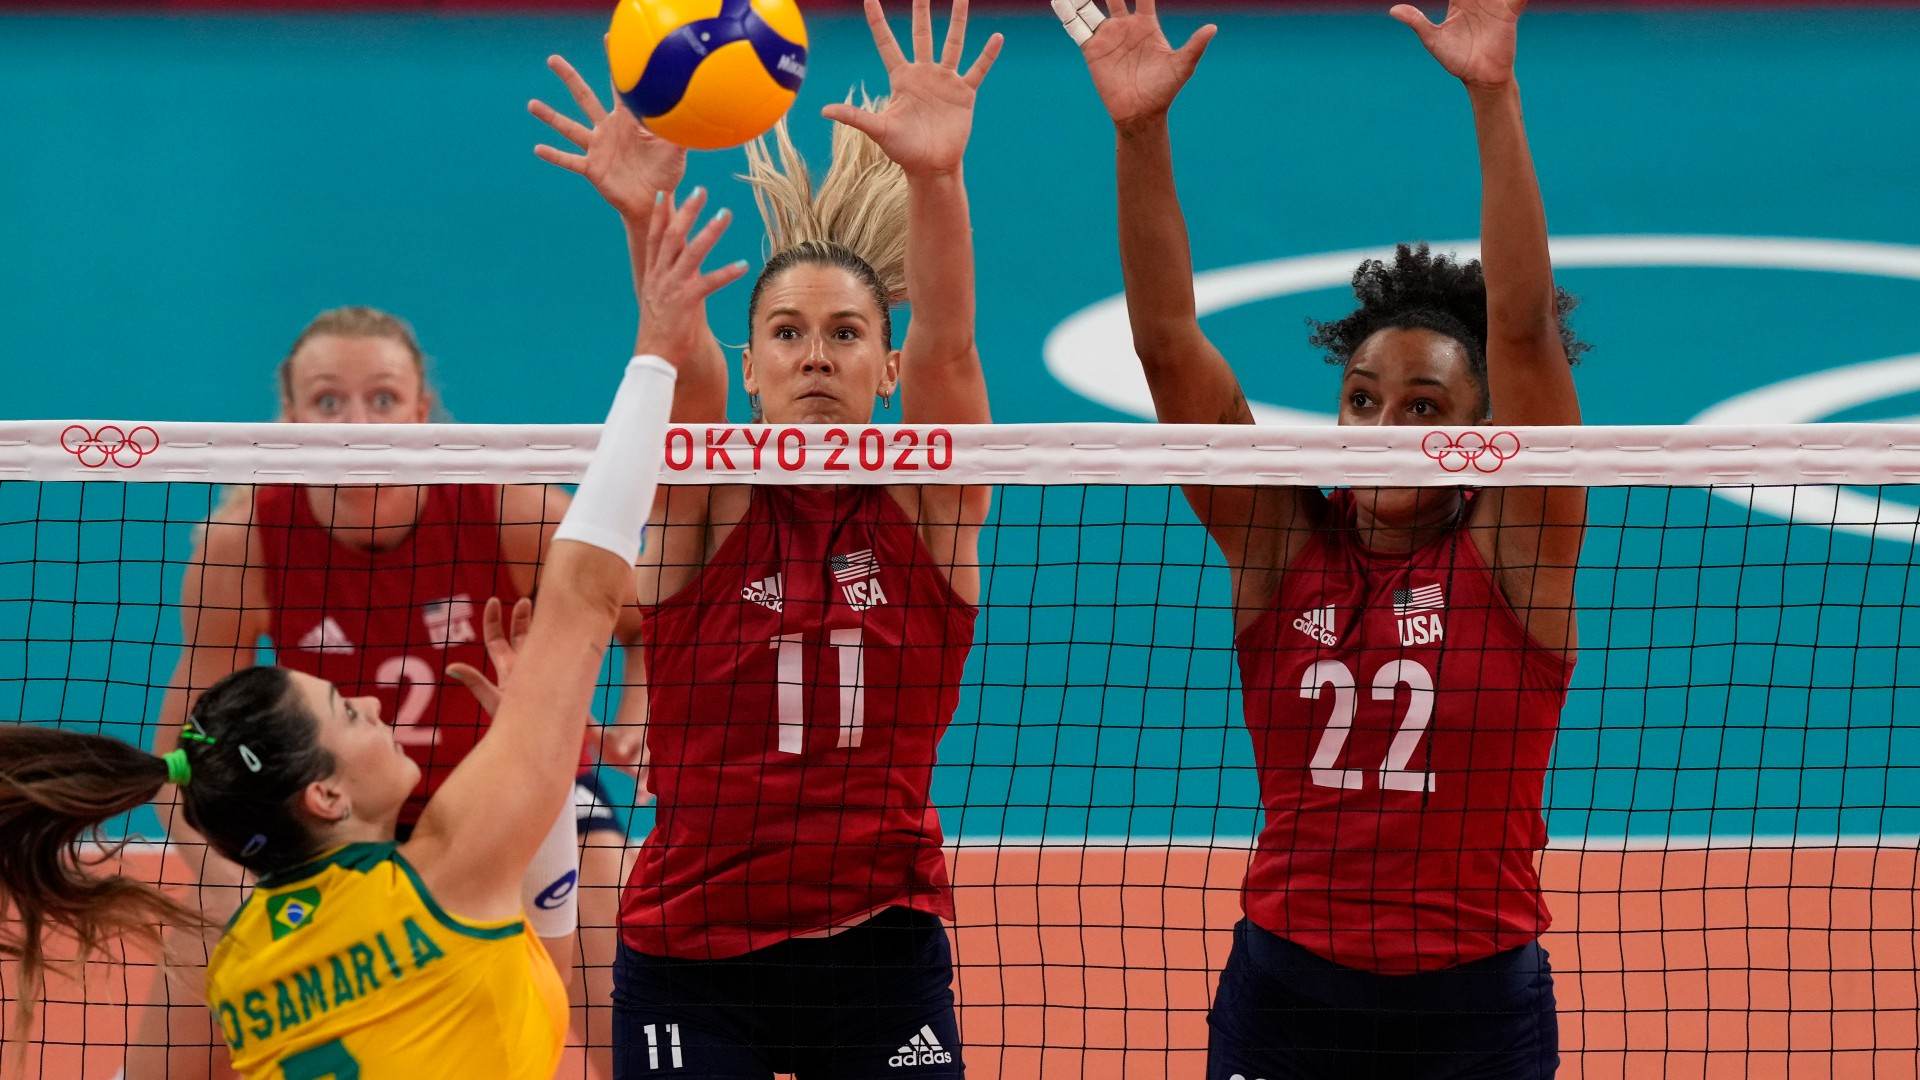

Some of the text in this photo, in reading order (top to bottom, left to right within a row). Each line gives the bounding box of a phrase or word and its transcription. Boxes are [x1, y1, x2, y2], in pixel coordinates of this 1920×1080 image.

[664, 428, 953, 471] OKYO 2020
[842, 577, 888, 612] USA
[1292, 617, 1338, 647] adidas
[1397, 613, 1444, 647] USA
[375, 656, 443, 746] 2
[769, 627, 865, 755] 11
[1299, 659, 1436, 793] 22
[215, 916, 444, 1050] OSAMARIA
[643, 1023, 683, 1070] 11
[888, 1049, 952, 1067] adidas
